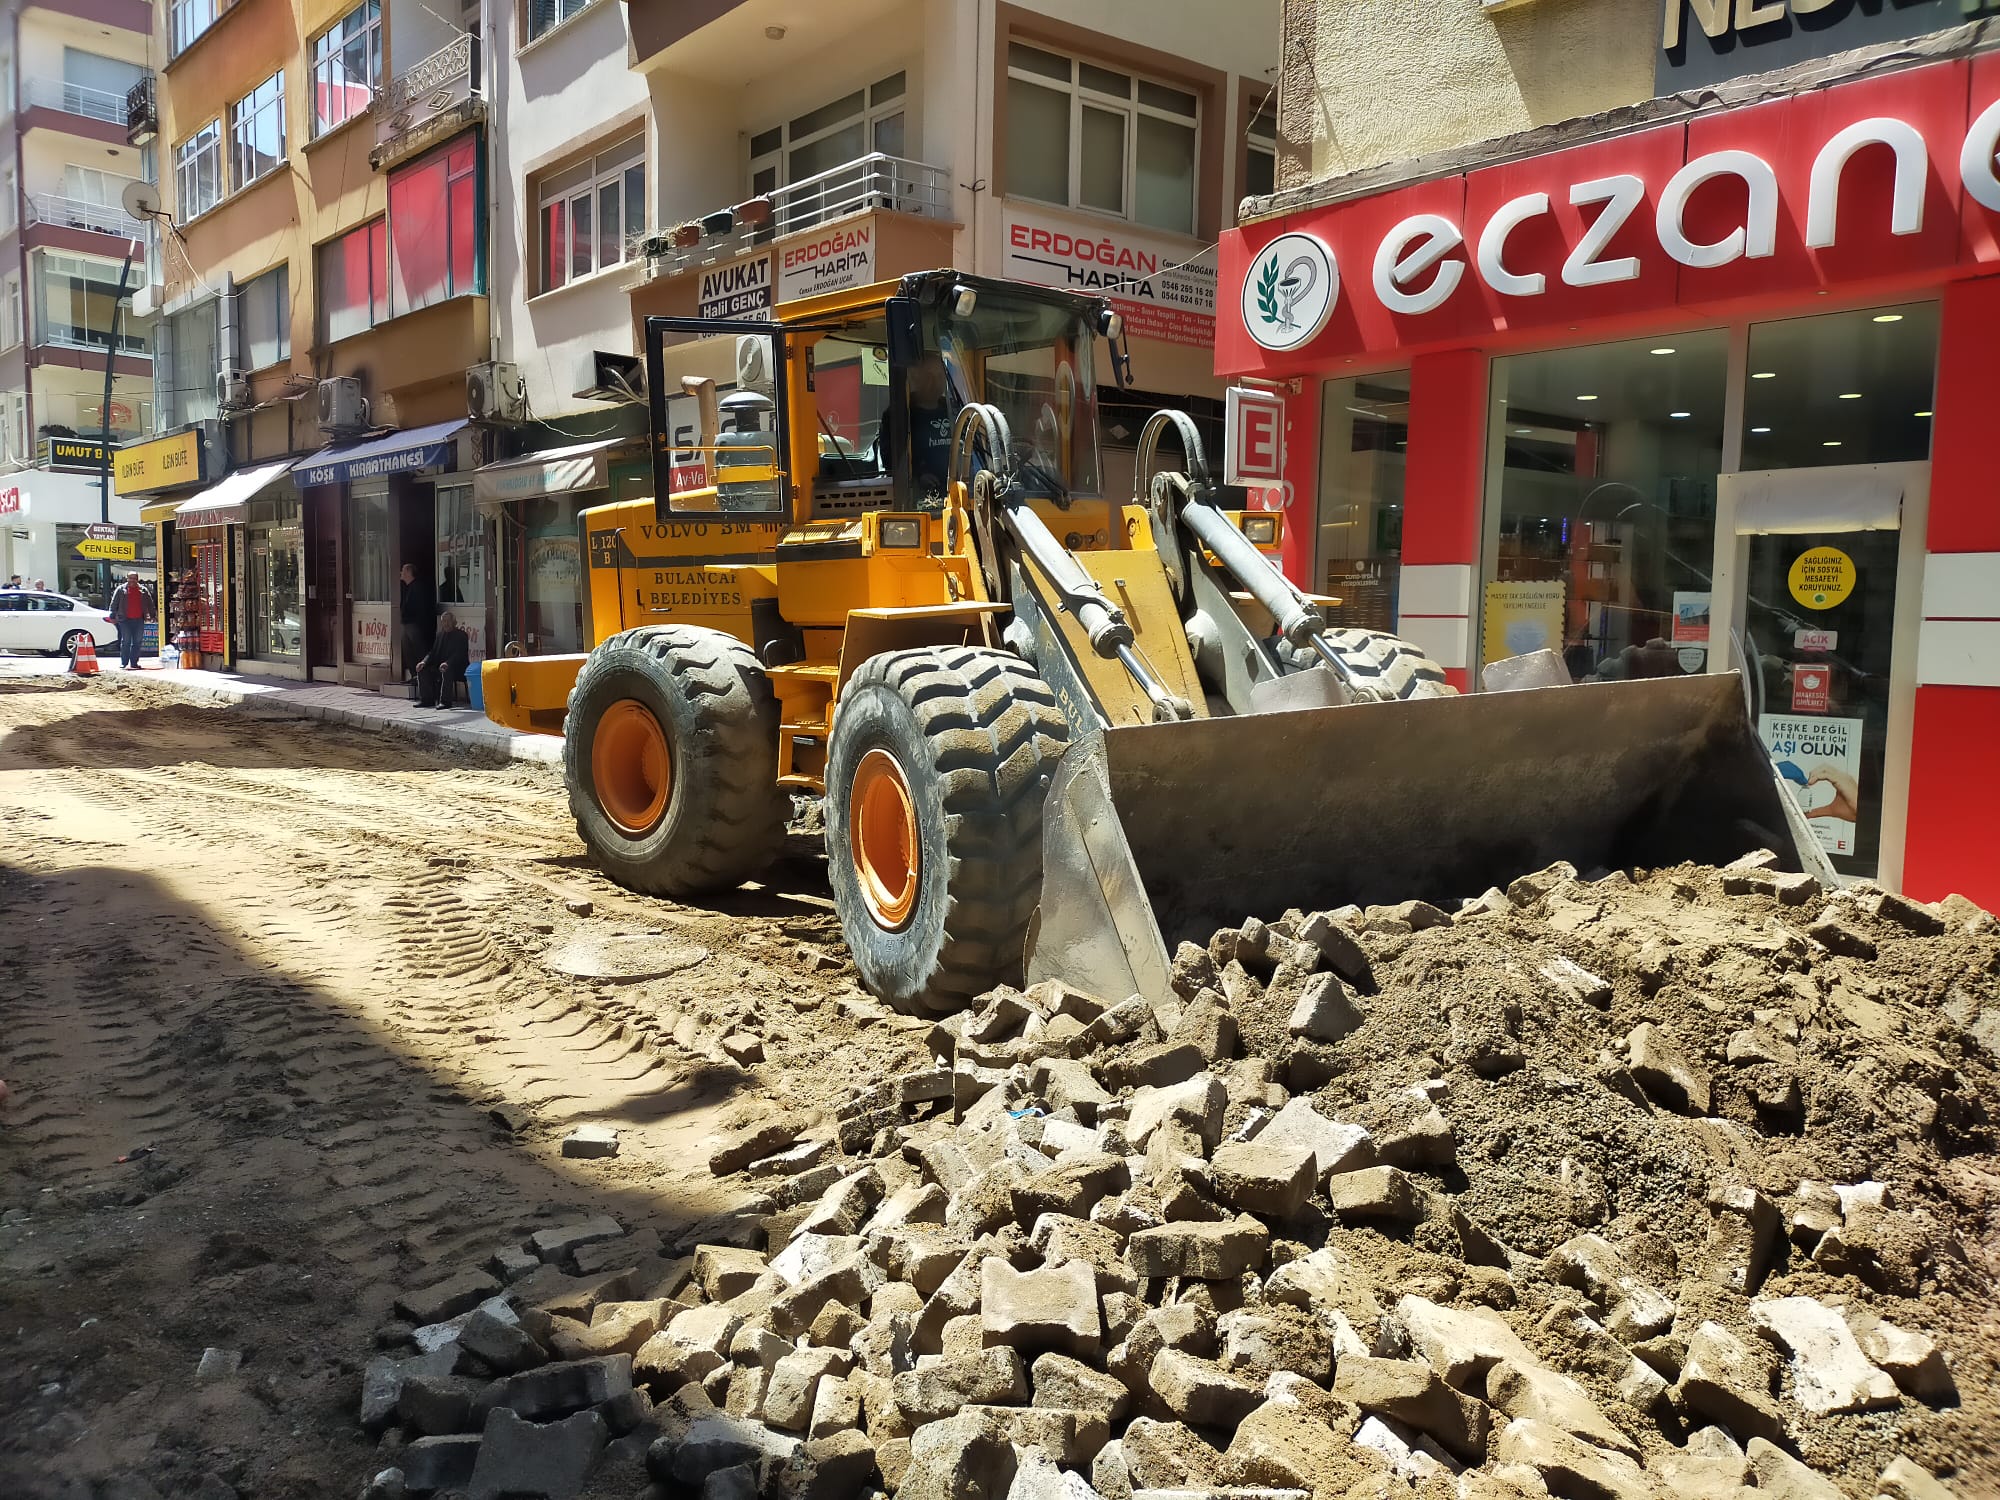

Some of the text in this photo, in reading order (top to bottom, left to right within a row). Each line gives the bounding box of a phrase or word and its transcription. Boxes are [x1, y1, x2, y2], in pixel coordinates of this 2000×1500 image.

[784, 226, 869, 268] ERDOĞAN
[1011, 223, 1156, 274] ERDOĞAN
[815, 251, 868, 279] HARİTA
[702, 257, 769, 300] AVUKAT
[1067, 266, 1155, 299] HARİTA
[1161, 281, 1179, 290] 0546
[1161, 291, 1178, 301] 0544
[703, 290, 765, 319] Halil GENÇ
[56, 445, 92, 458] UMUT
[309, 448, 424, 485] KÖŞK KIRAATHANESİ
[640, 523, 707, 540] VOLVO
[84, 544, 132, 555] FEN LİSESİ
[591, 537, 598, 550] L
[604, 552, 611, 565] B
[1804, 555, 1842, 565] SAĞLIĞINIZ
[1802, 565, 1815, 574] İÇİN
[1805, 574, 1839, 582] MESAFEYİ
[1799, 584, 1843, 592] KORUYUNUZ.
[651, 588, 741, 605] BELEDİYES
[1803, 635, 1828, 645] AÇIK
[1772, 722, 1848, 735] KEŞKE DEĞİL
[1798, 734, 1825, 742] DEMEK
[1829, 735, 1847, 744] İÇİN
[1772, 740, 1846, 757] AŞI OLUN
[1837, 840, 1846, 849] E
